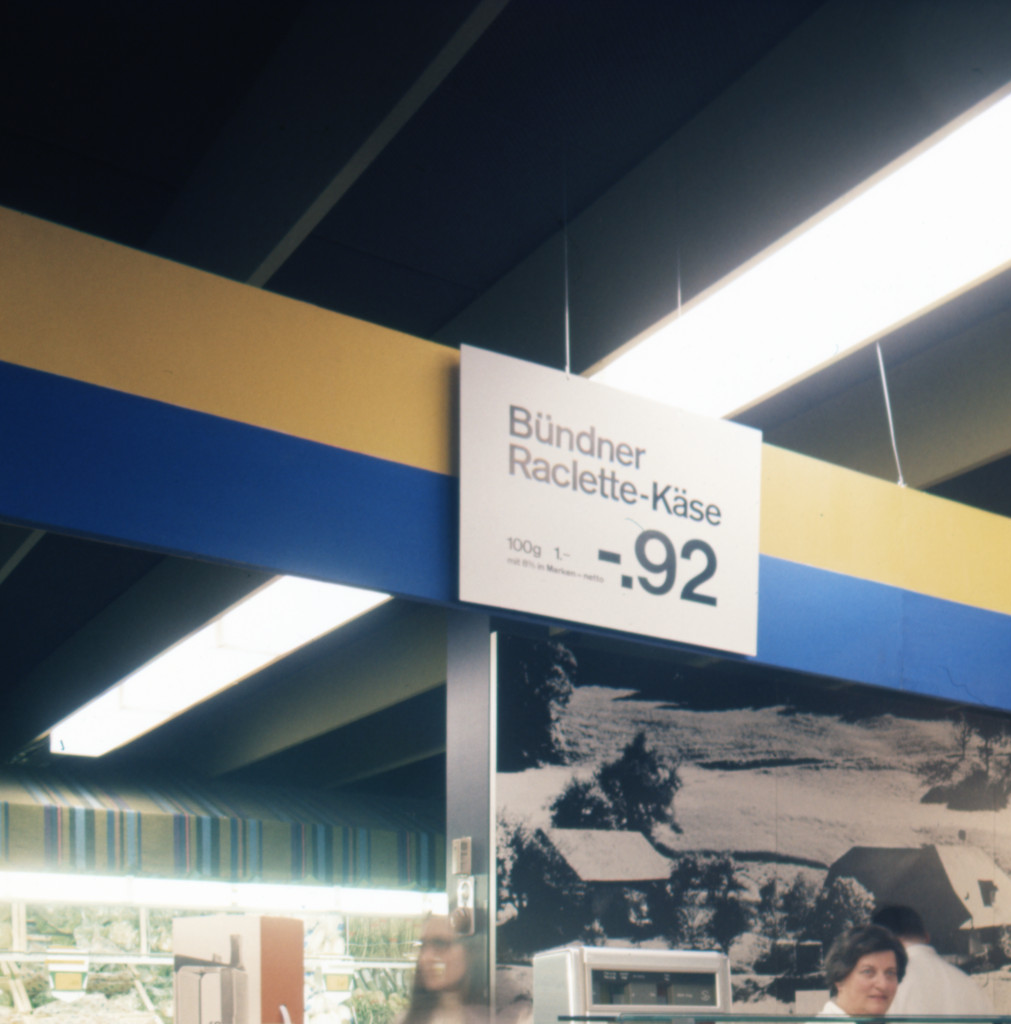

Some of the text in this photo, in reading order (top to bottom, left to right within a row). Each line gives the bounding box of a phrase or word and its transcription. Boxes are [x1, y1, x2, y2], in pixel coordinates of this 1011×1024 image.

[509, 404, 646, 469] Bündner
[508, 443, 721, 526] Raclette-Käse
[507, 537, 541, 558] 100g
